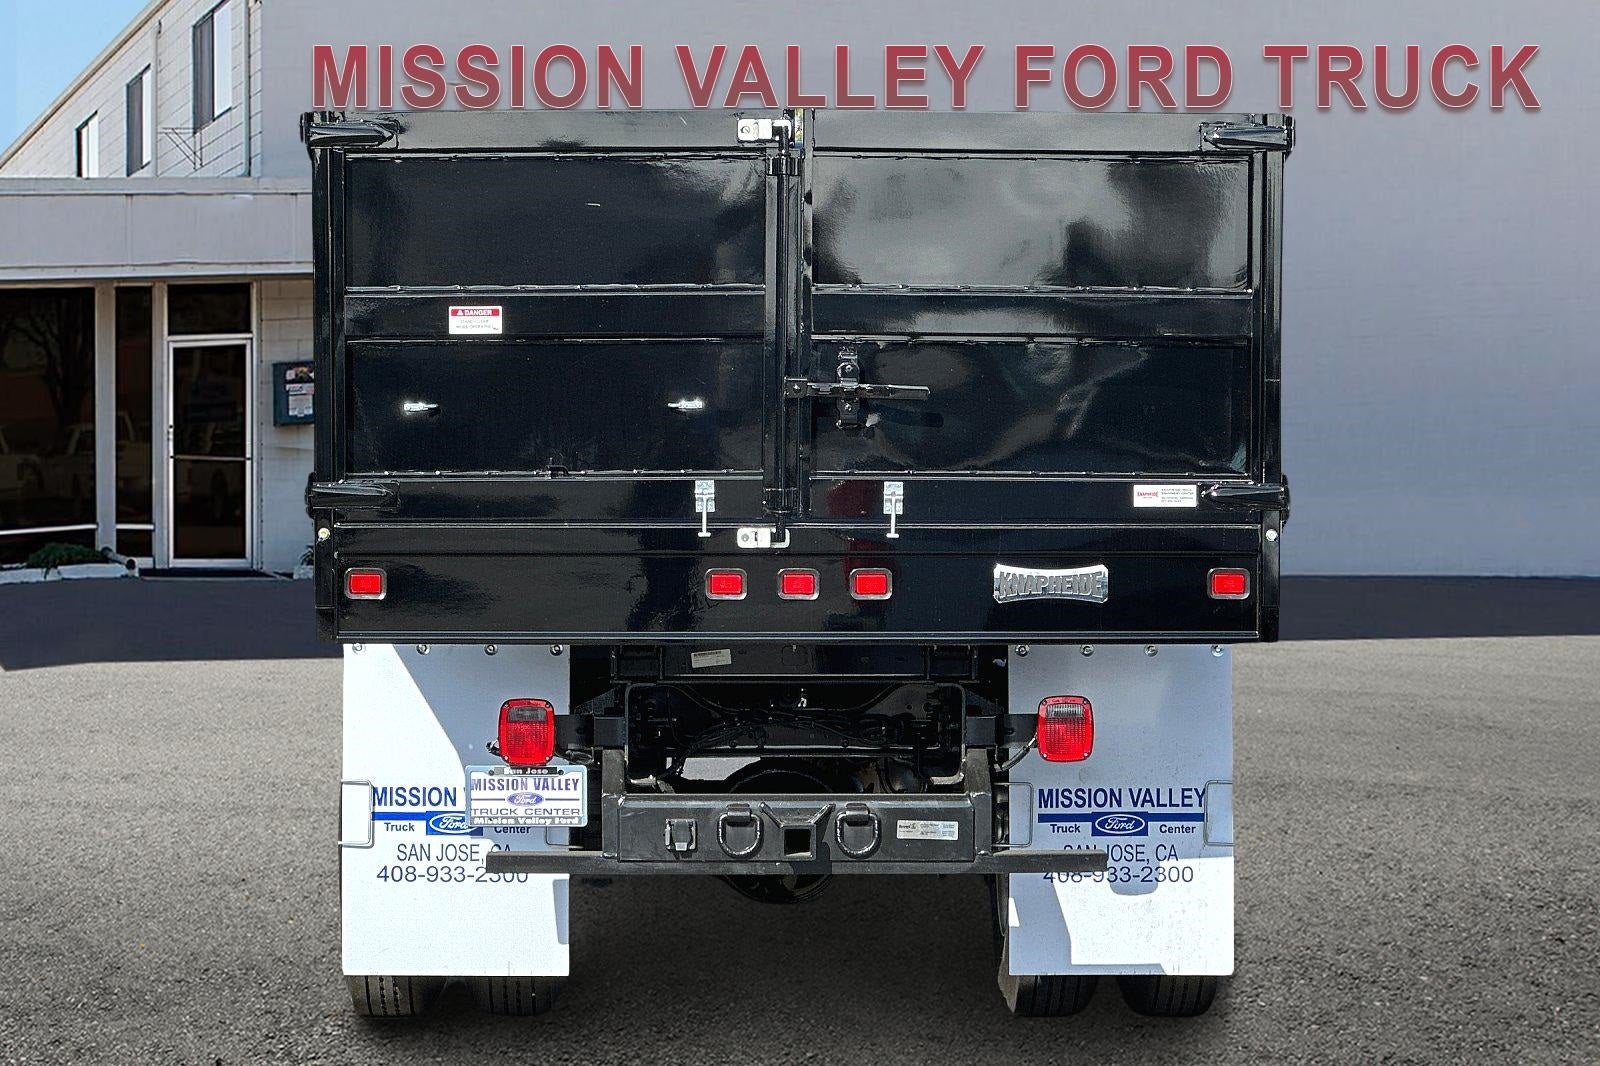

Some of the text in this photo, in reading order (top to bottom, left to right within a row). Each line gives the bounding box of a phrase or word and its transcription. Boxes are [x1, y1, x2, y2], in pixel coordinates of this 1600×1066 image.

[1000, 571, 1102, 598] KNAPHEIDE
[503, 767, 549, 775] San Jose
[471, 778, 580, 791] MISSION VALLEY
[373, 786, 457, 807] MISSION
[513, 794, 537, 805] Ford
[1038, 787, 1207, 809] MISSION VALLEY
[472, 808, 580, 816] TRUCK CENTER
[384, 822, 415, 832] Truck
[474, 817, 515, 825] Mission
[518, 817, 552, 826] Valley
[1050, 816, 1196, 834] Truck Ford Center
[397, 843, 484, 865] SAN JOSE,
[1155, 844, 1179, 862] CA
